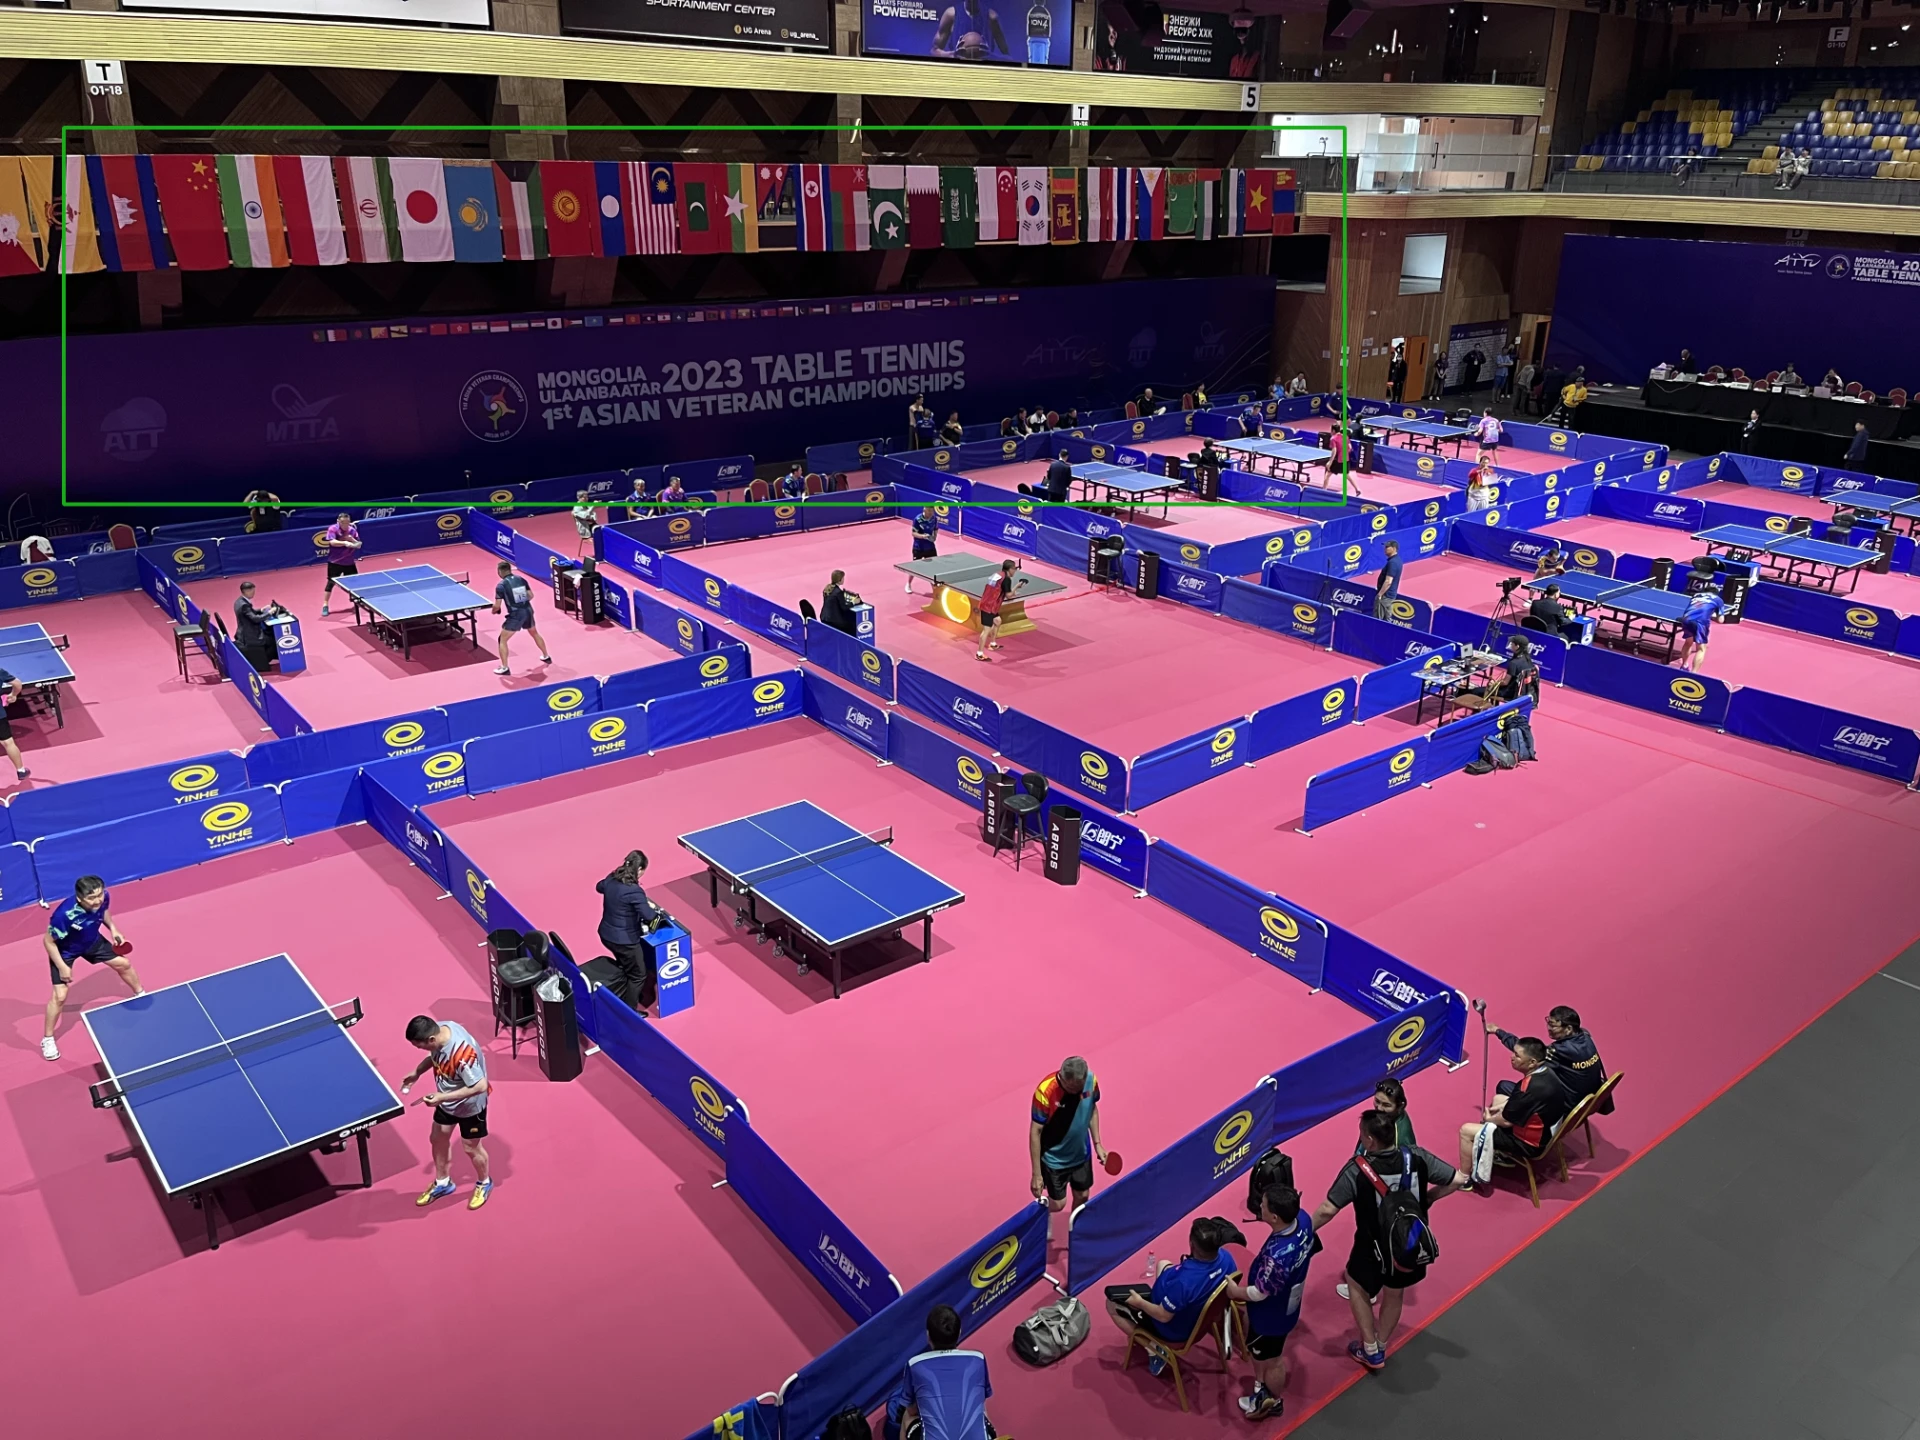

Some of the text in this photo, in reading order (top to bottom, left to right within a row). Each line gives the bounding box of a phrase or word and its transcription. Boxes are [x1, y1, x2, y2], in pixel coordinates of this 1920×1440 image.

[734, 4, 775, 16] CENTER
[1169, 15, 1201, 26] ЭНЕРЖИ
[743, 26, 771, 36] UG Arena
[1168, 26, 1197, 38] РЕСУРС
[1833, 29, 1844, 40] F
[95, 63, 111, 81] T
[90, 85, 123, 95] 01-18
[1246, 87, 1256, 107] 5
[1078, 106, 1085, 118] T
[1855, 257, 1895, 265] MONGOLIA
[1853, 268, 1888, 278] TABLE
[661, 339, 965, 393] 2023 TABLE TENNIS
[537, 366, 648, 390] MONGOLIA
[539, 381, 661, 404] ULAANBAATAR
[541, 370, 966, 430] 1st ASIAN VETERAN CHAMPIONSHIPS
[266, 417, 340, 442] MTTA
[103, 429, 164, 452] ATT
[1138, 559, 1146, 590] ABROS
[553, 569, 561, 601] ABROS
[593, 582, 601, 614] ABROS
[1844, 625, 1875, 638] YINHE
[700, 676, 729, 688] YINHE
[754, 702, 785, 714] YINHE
[1668, 699, 1703, 713] YINHE
[550, 710, 584, 722] YINHE
[591, 739, 626, 753] YINHE
[1855, 732, 1890, 750] 朗宁
[426, 775, 465, 791] YINHE
[1080, 773, 1107, 792] YINHE
[174, 789, 219, 804] YINHE
[206, 827, 253, 845] YINHE
[1050, 823, 1060, 870] ABROS
[670, 943, 678, 957] 5
[1260, 933, 1297, 958] YINHE
[490, 952, 500, 1005] ABROS
[661, 976, 690, 990] YINHE
[536, 1003, 546, 1060] ABROS
[1386, 1048, 1420, 1071] YINHE
[1572, 1053, 1600, 1070] MONGO
[351, 1120, 378, 1133] YINHE
[693, 1106, 726, 1141] YINHE
[1213, 1142, 1251, 1175] YINHE
[972, 1266, 1017, 1309] YINHE
